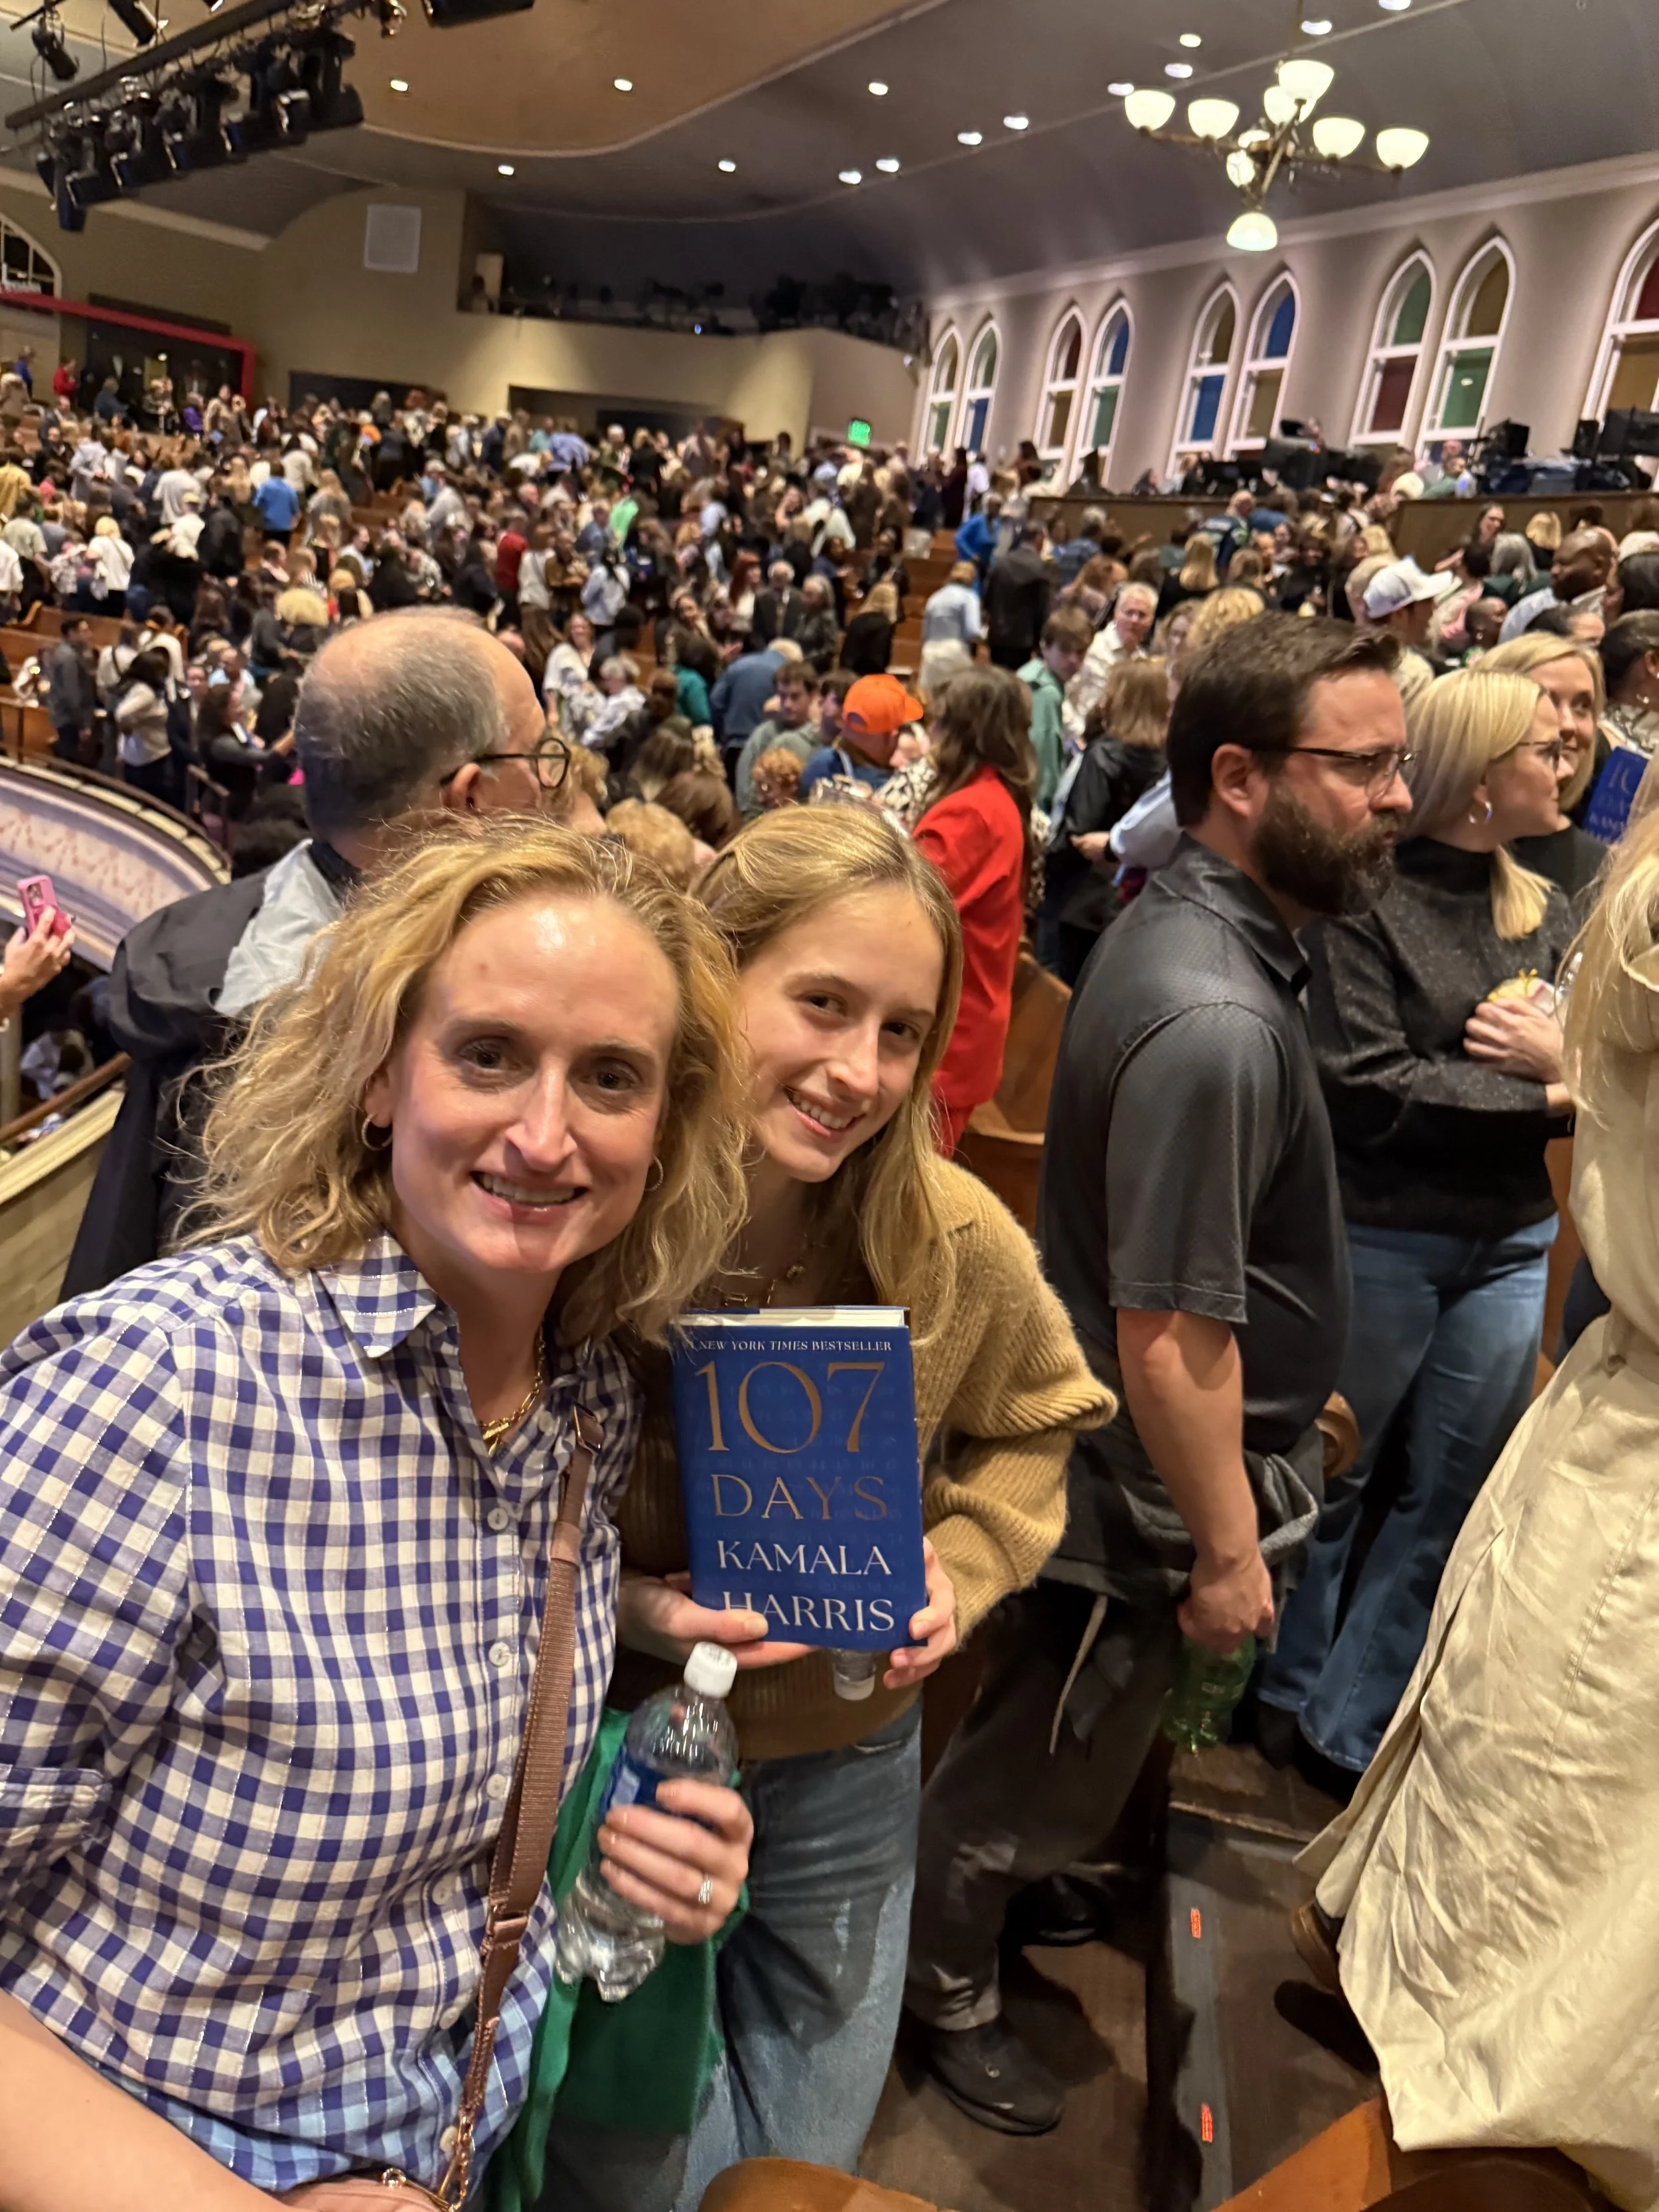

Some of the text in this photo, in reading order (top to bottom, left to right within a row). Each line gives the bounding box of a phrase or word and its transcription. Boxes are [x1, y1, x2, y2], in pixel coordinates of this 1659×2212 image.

[699, 1341, 892, 1351] NEW YORK TIMES BESTSELLER
[695, 1361, 885, 1453] 107
[711, 1474, 887, 1520] DAYS
[717, 1540, 892, 1576] KAMALA
[723, 1591, 895, 1631] HARRIS
